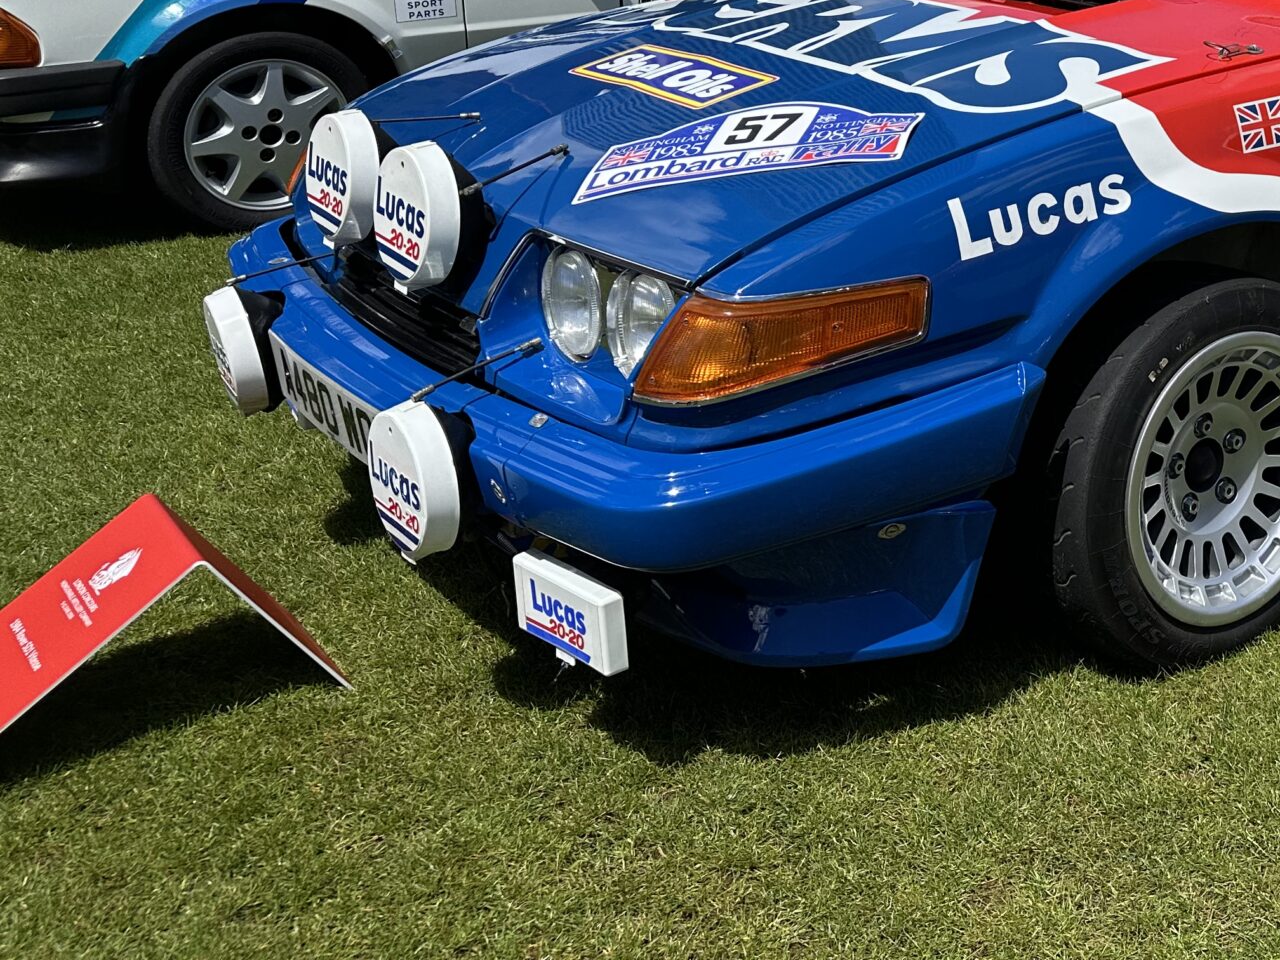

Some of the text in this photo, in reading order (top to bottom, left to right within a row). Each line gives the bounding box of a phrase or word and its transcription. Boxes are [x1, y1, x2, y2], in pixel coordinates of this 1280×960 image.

[407, 0, 444, 10] SPORT
[409, 9, 445, 19] PARTS
[596, 53, 738, 98] Shell Oils
[724, 112, 804, 145] 57
[807, 127, 859, 143] 1985
[812, 117, 913, 131] NOTTINGHAM
[613, 134, 710, 155] NOTTINGHAM
[651, 142, 705, 160] 1985
[308, 141, 348, 197] Lucas
[587, 135, 894, 190] Lombard RAC rally
[319, 189, 344, 217] 20-20
[376, 175, 426, 239] Lucas
[946, 174, 1132, 261] Lucas
[389, 228, 420, 261] 20-20
[280, 348, 339, 436] A480
[369, 440, 421, 511] Lucas
[388, 497, 420, 534] 20-20
[529, 578, 587, 636] Lucas
[549, 620, 585, 651] 20-20
